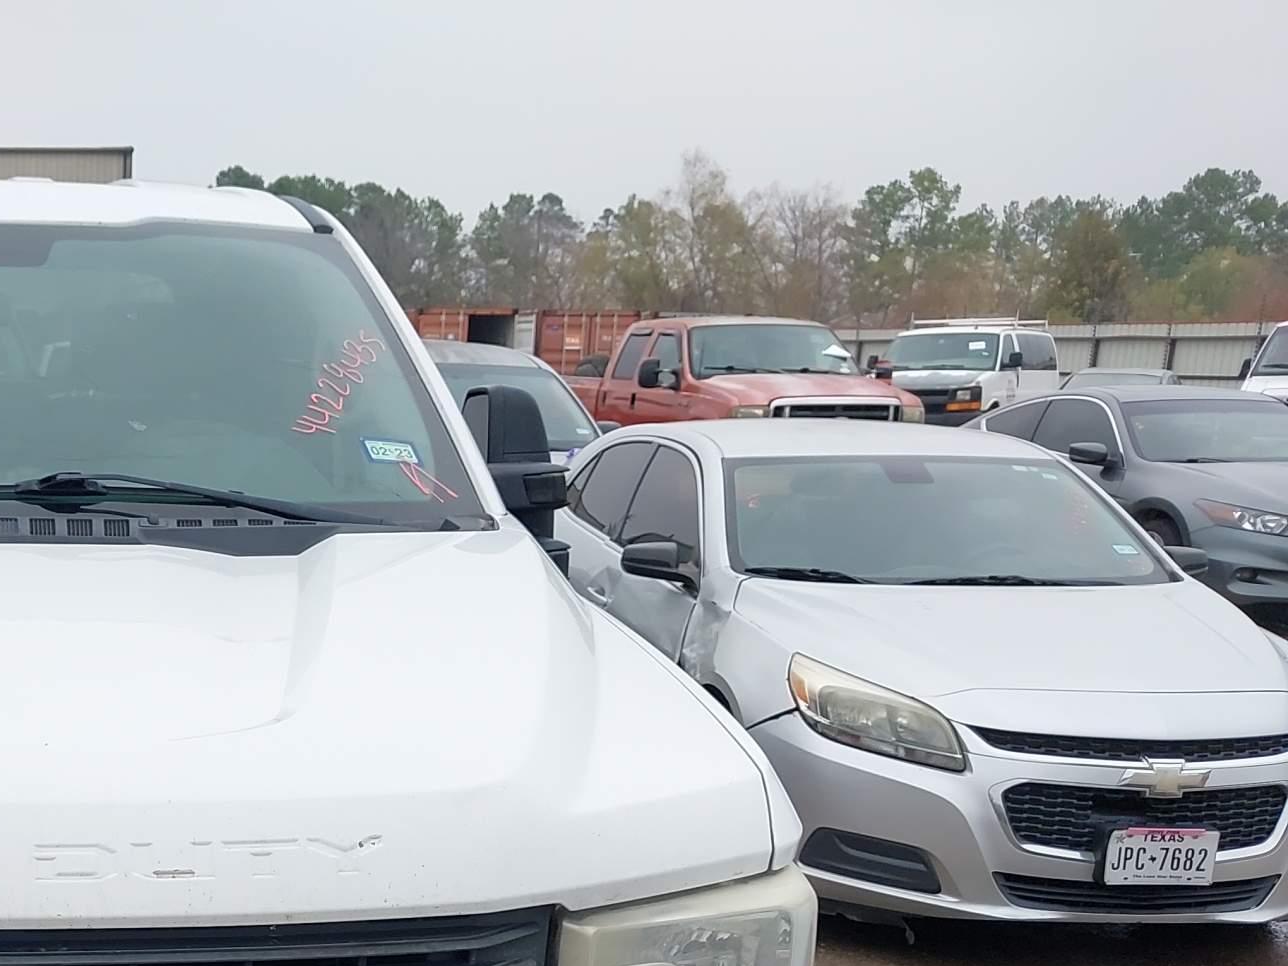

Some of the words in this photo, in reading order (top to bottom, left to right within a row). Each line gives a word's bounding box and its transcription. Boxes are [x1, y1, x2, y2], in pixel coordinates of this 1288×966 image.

[291, 329, 386, 434] 44228435
[1143, 831, 1185, 843] TEXAS
[32, 832, 384, 882] DUTY
[1111, 846, 1147, 871] JPC
[1158, 847, 1208, 872] 7682
